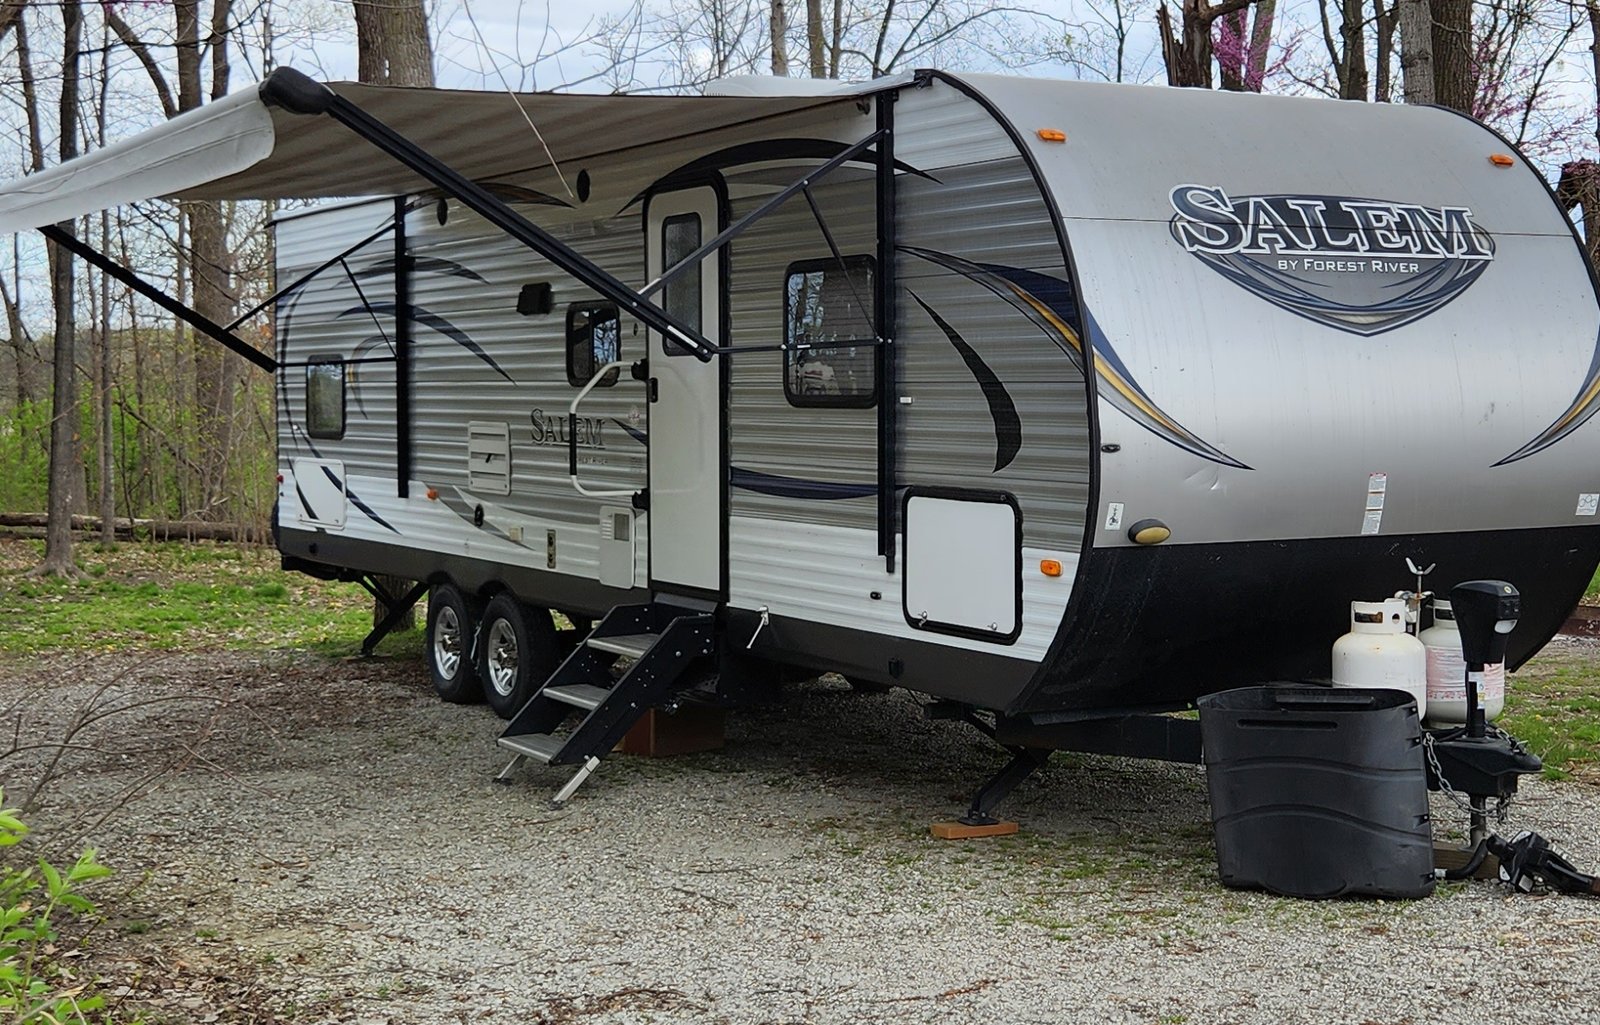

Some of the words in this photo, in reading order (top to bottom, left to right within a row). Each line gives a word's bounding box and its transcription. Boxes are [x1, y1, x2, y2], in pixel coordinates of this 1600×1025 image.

[1169, 184, 1494, 260] SALEM
[1278, 260, 1298, 270] BY
[1303, 259, 1366, 272] FOREST
[1371, 260, 1419, 273] RIVER
